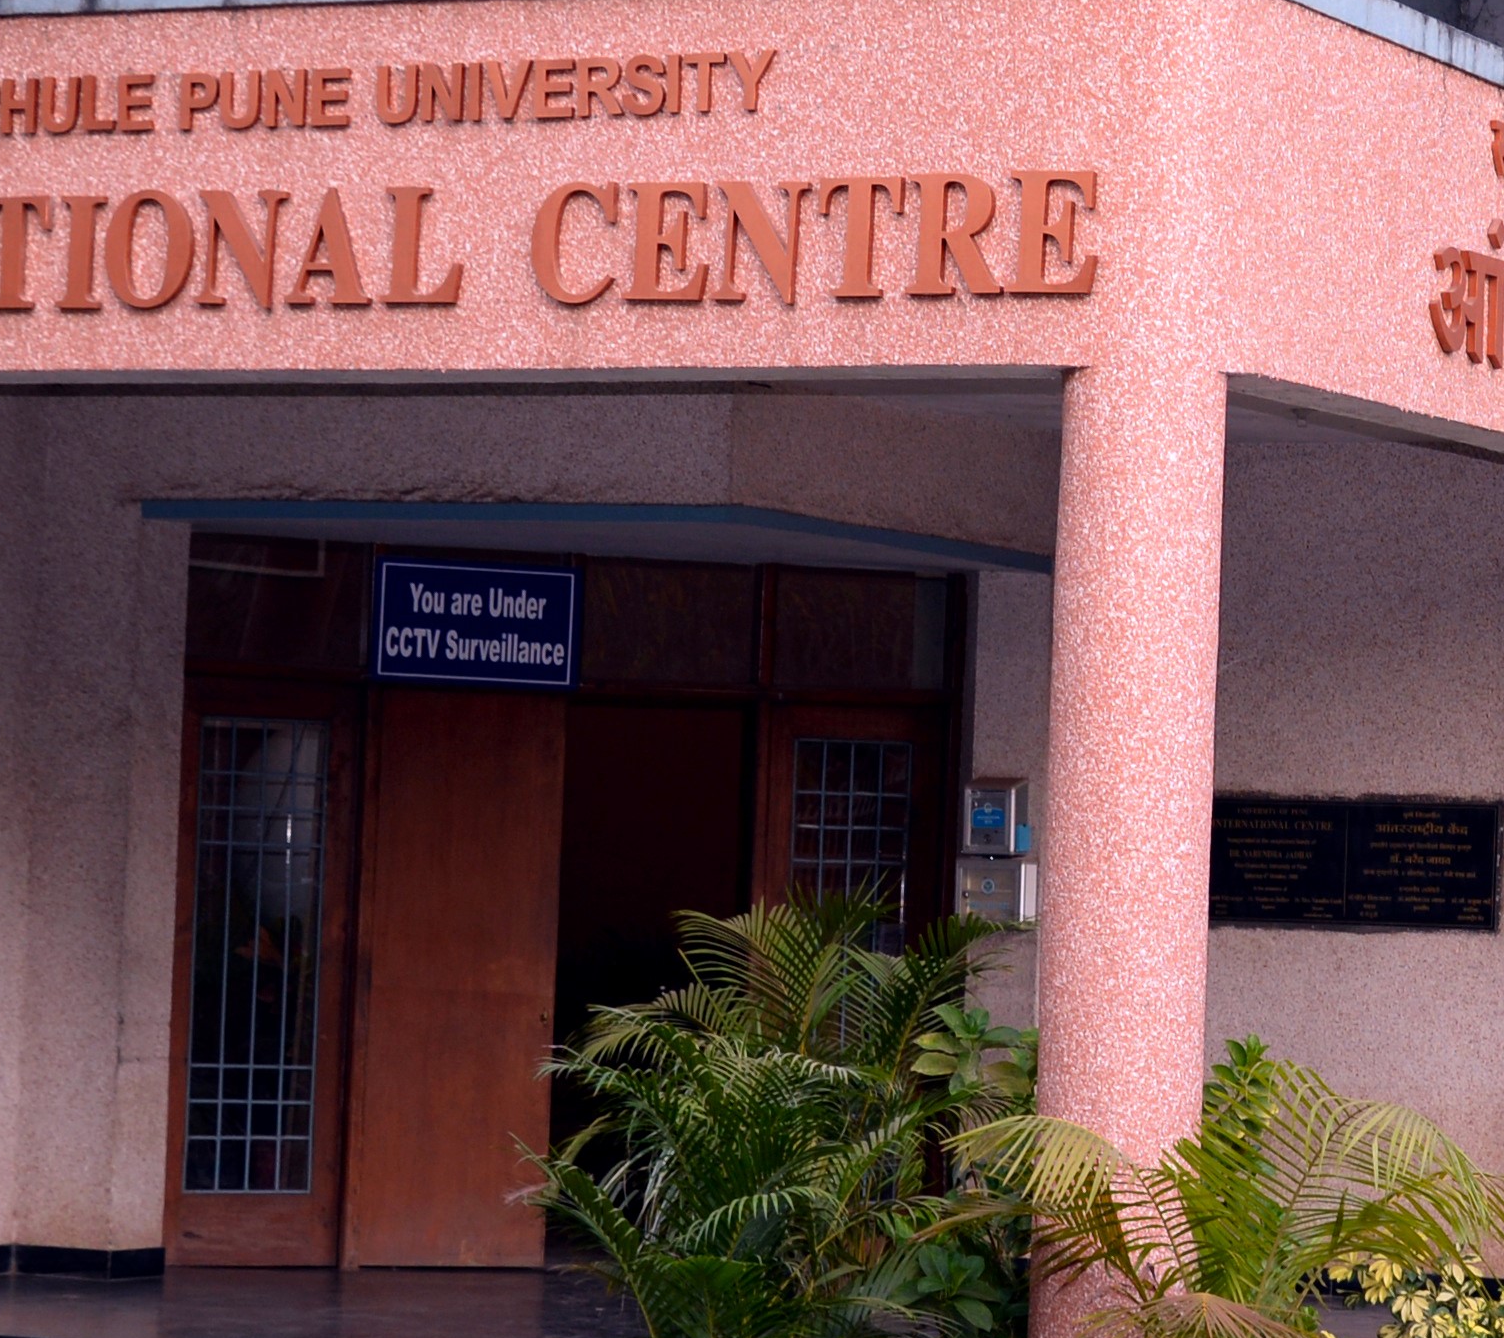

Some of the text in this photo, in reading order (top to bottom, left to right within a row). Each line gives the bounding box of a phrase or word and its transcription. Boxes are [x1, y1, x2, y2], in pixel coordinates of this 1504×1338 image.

[179, 67, 353, 129] PUNE
[376, 49, 777, 124] UNIVERSITY
[530, 169, 1100, 306] CENTRE
[410, 582, 547, 620] You are Under
[385, 626, 566, 666] CCTV Surveillance
[1294, 820, 1334, 831] CENTRE
